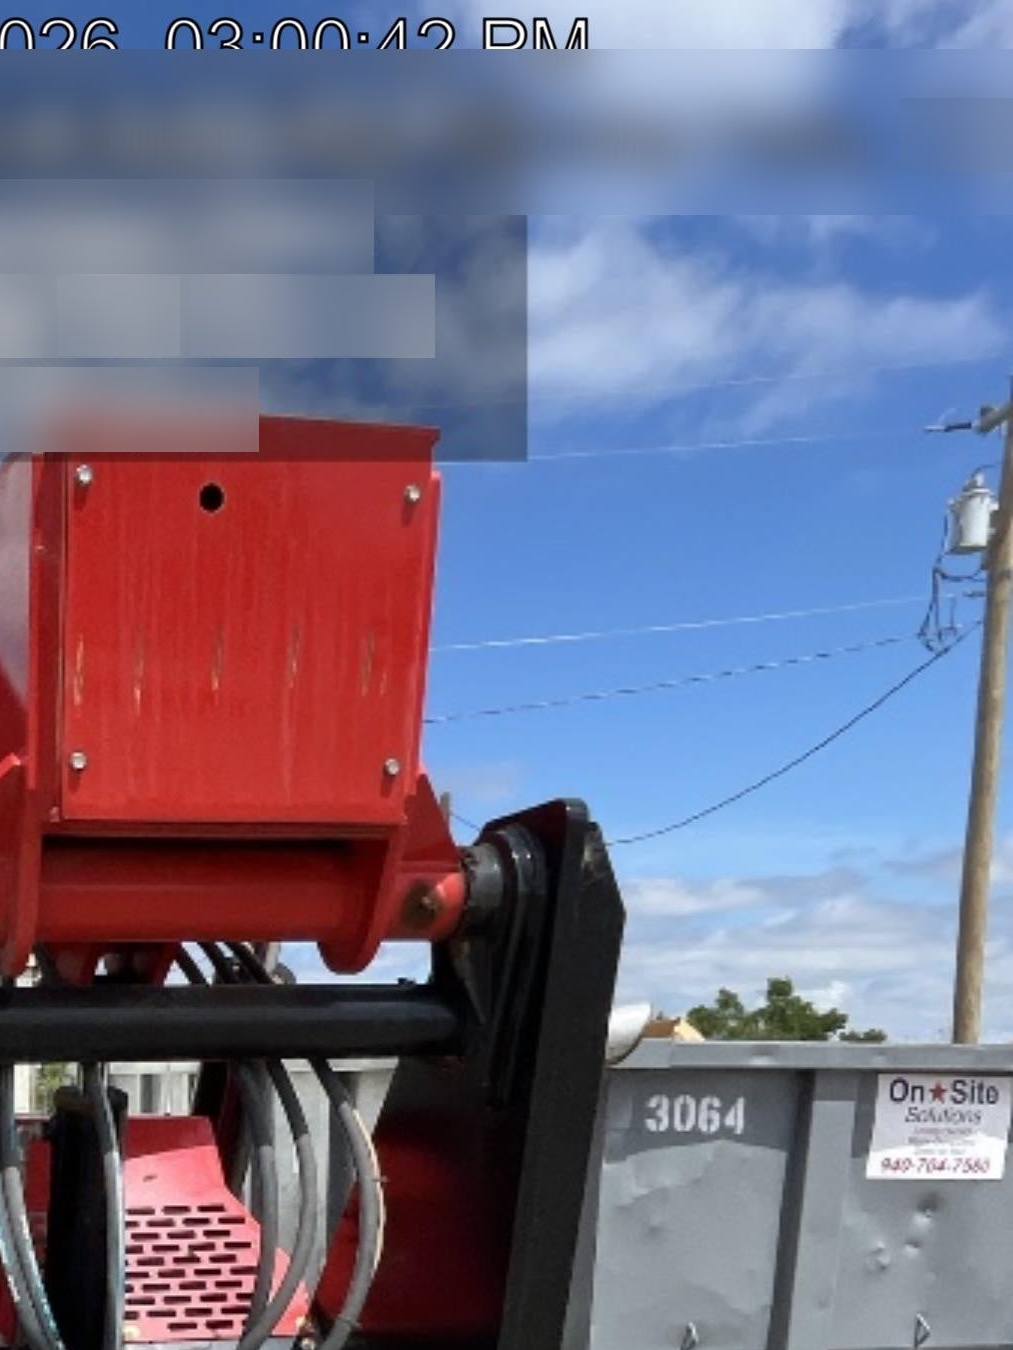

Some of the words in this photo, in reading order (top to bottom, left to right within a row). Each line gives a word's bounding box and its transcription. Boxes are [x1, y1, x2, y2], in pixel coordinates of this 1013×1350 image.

[890, 1077, 925, 1102] On
[950, 1079, 1000, 1105] Site
[645, 1093, 745, 1135] 3064
